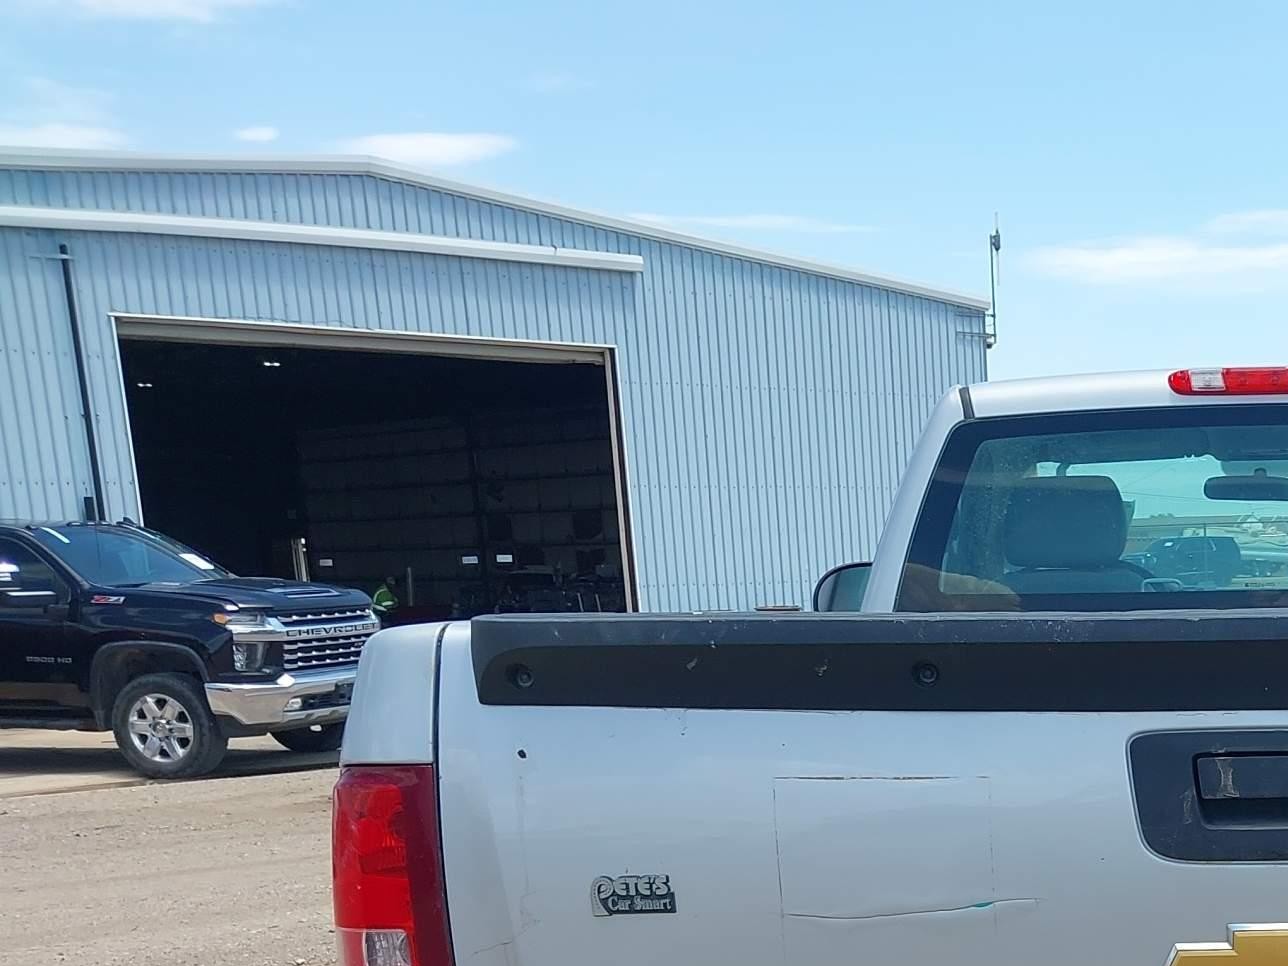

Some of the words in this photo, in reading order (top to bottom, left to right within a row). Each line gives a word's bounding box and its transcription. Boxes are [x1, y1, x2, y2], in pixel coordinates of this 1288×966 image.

[286, 622, 377, 637] CHEVROLET
[57, 656, 73, 664] HD
[608, 896, 631, 911] Car
[633, 895, 672, 911] Smart
